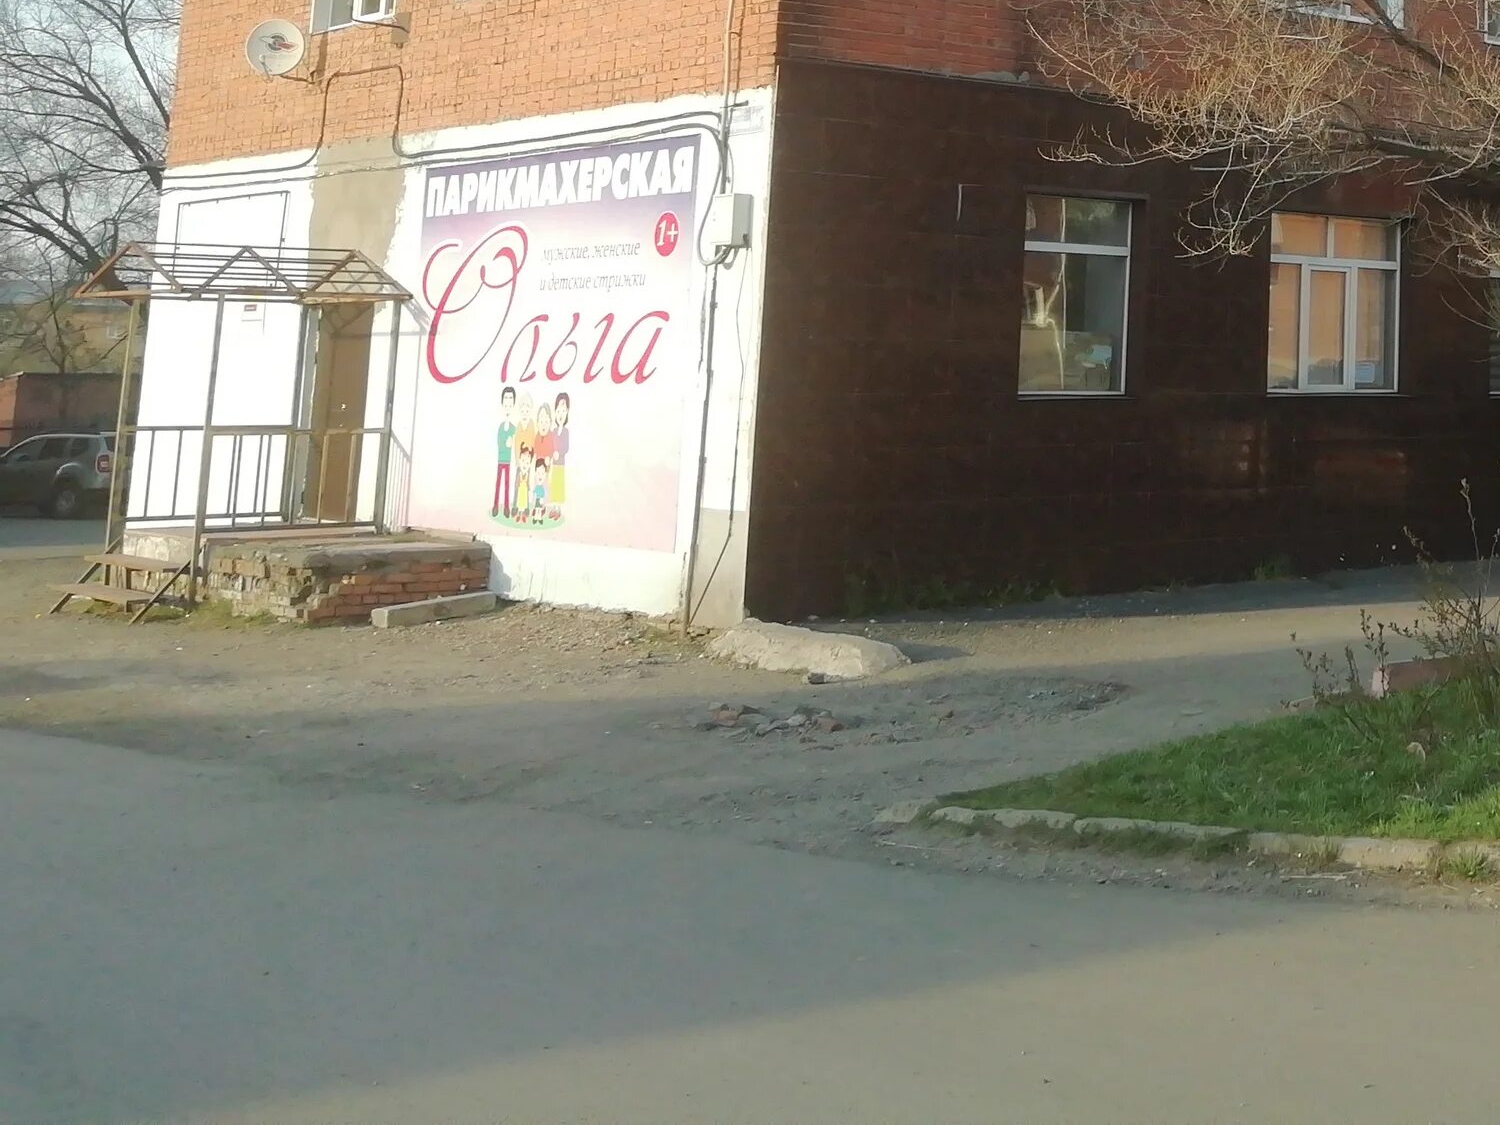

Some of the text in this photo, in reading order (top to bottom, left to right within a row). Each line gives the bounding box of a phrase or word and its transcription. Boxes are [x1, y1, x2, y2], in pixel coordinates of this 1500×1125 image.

[426, 146, 695, 218] ПАРИКМАХЕРСКАЯ
[656, 220, 680, 246] 1+
[592, 242, 641, 258] женские
[548, 273, 591, 291] детские
[593, 274, 646, 293] стрижки
[422, 225, 670, 385] Ольга
